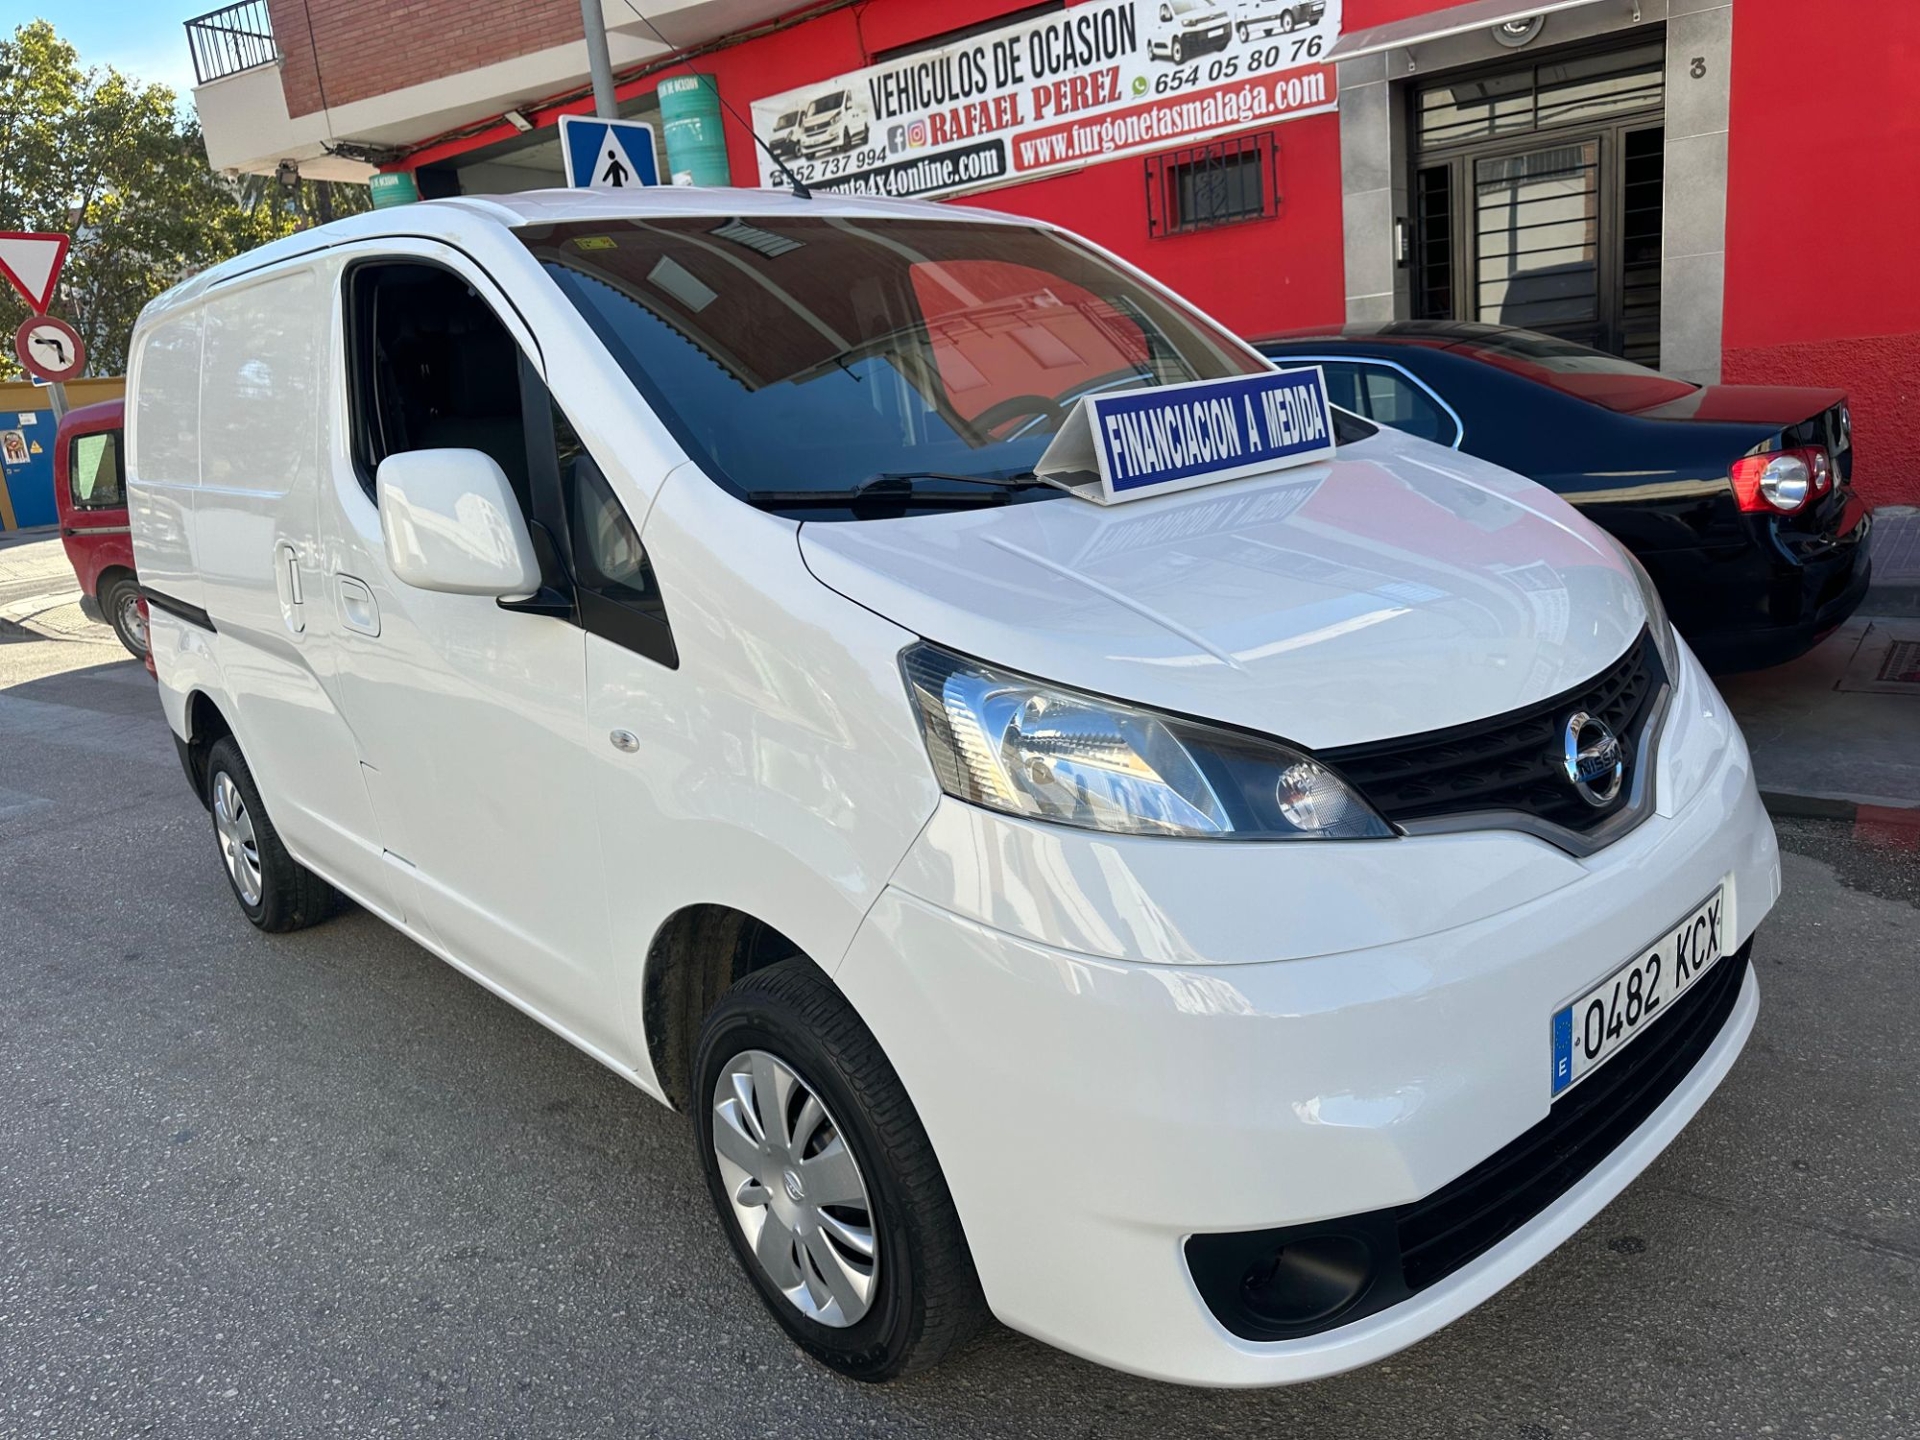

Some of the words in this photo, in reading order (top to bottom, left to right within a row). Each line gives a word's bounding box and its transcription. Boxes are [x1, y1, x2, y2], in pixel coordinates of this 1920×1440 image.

[869, 46, 987, 120] VEHICULOS
[993, 36, 1024, 89] DE
[1029, 2, 1137, 79] OCASION
[1155, 65, 1199, 94] 654
[1208, 55, 1239, 81] 05
[1250, 45, 1280, 71] 80
[1290, 34, 1323, 61] 76
[1690, 56, 1706, 79] 3
[928, 92, 1024, 146] RAFAEL
[1032, 65, 1121, 121] PEREZ
[1019, 71, 1325, 167] www.furgonetasmalaga.com
[821, 155, 851, 177] 737
[857, 145, 887, 169] 994
[1105, 397, 1242, 479] FINANCIACION
[1243, 394, 1262, 453] A
[1260, 383, 1326, 449] MEDIDA
[1584, 953, 1662, 1060] 0482
[1675, 898, 1720, 989] KCX
[1558, 1057, 1568, 1077] E
